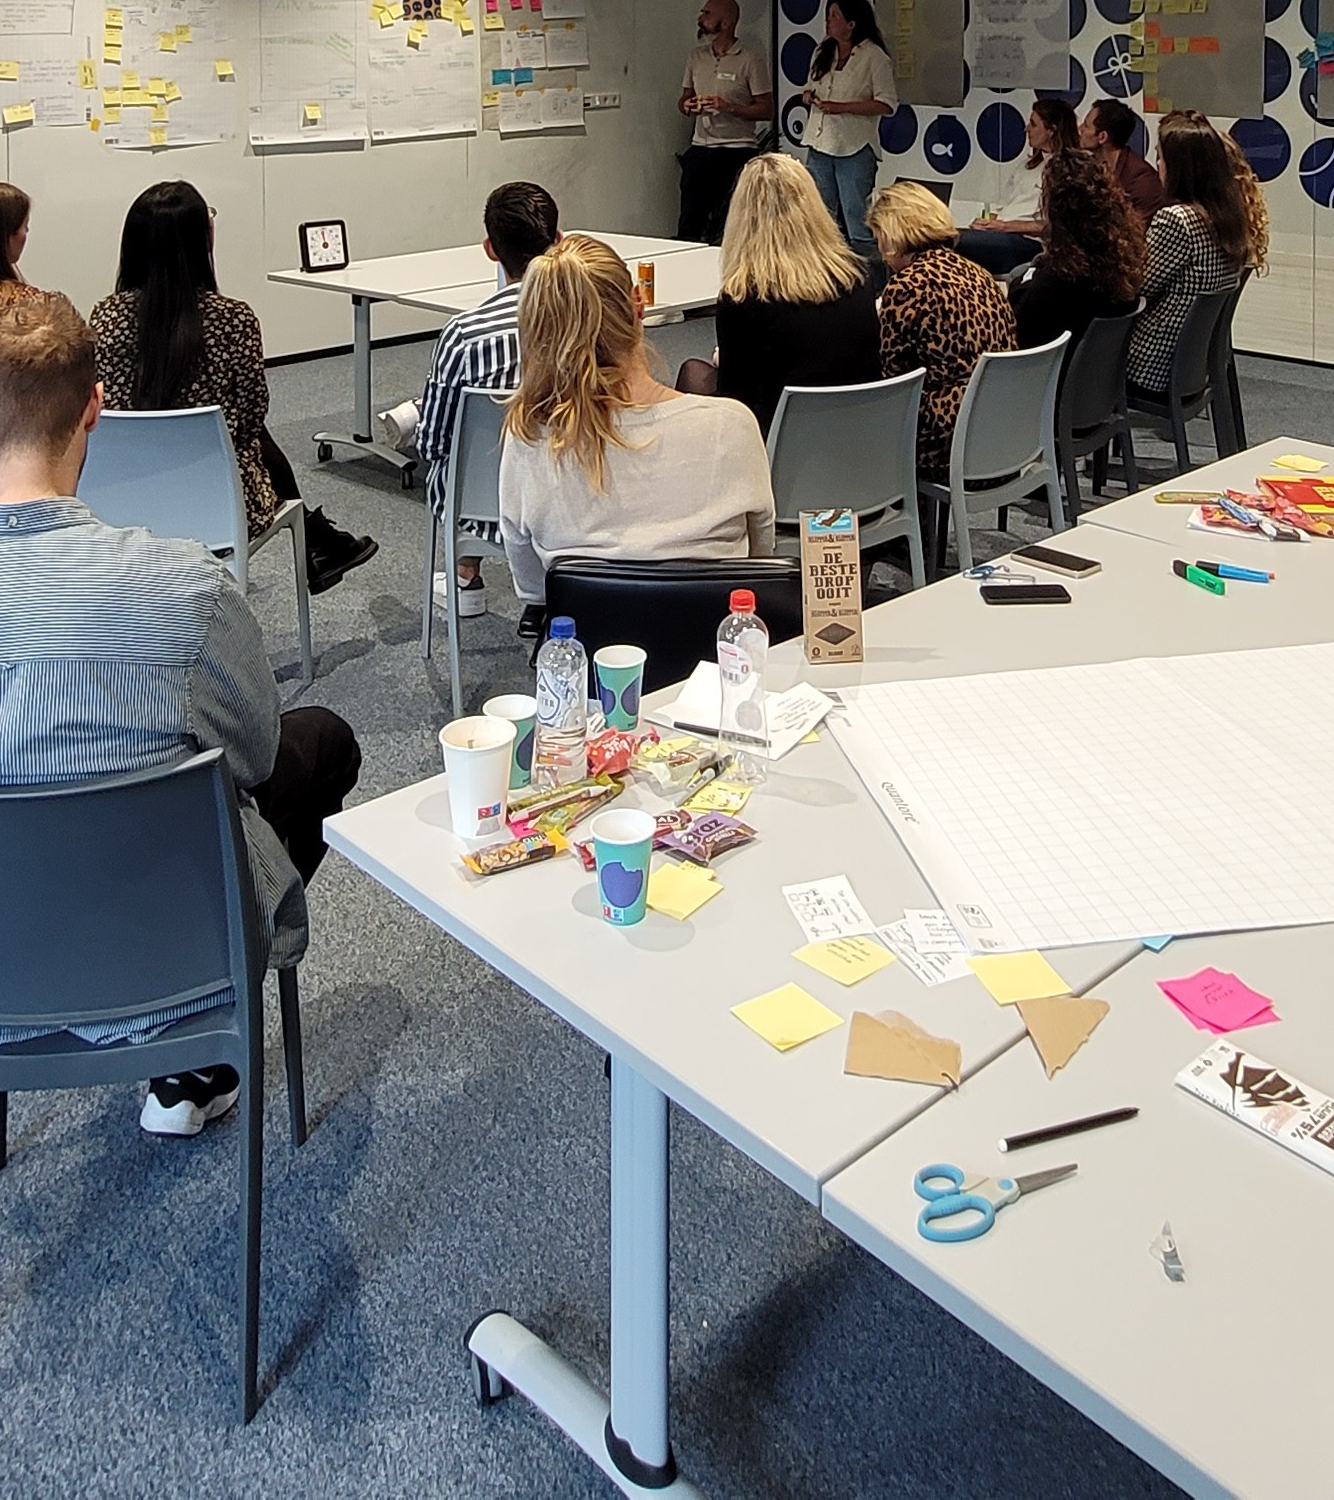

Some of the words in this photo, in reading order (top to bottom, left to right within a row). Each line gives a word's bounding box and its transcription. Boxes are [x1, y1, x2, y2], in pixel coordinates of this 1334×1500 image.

[823, 552, 843, 564] DE
[809, 564, 858, 577] BESTE
[814, 576, 854, 588] DROP
[816, 587, 852, 600] OOIT
[881, 781, 917, 823] Quantore
